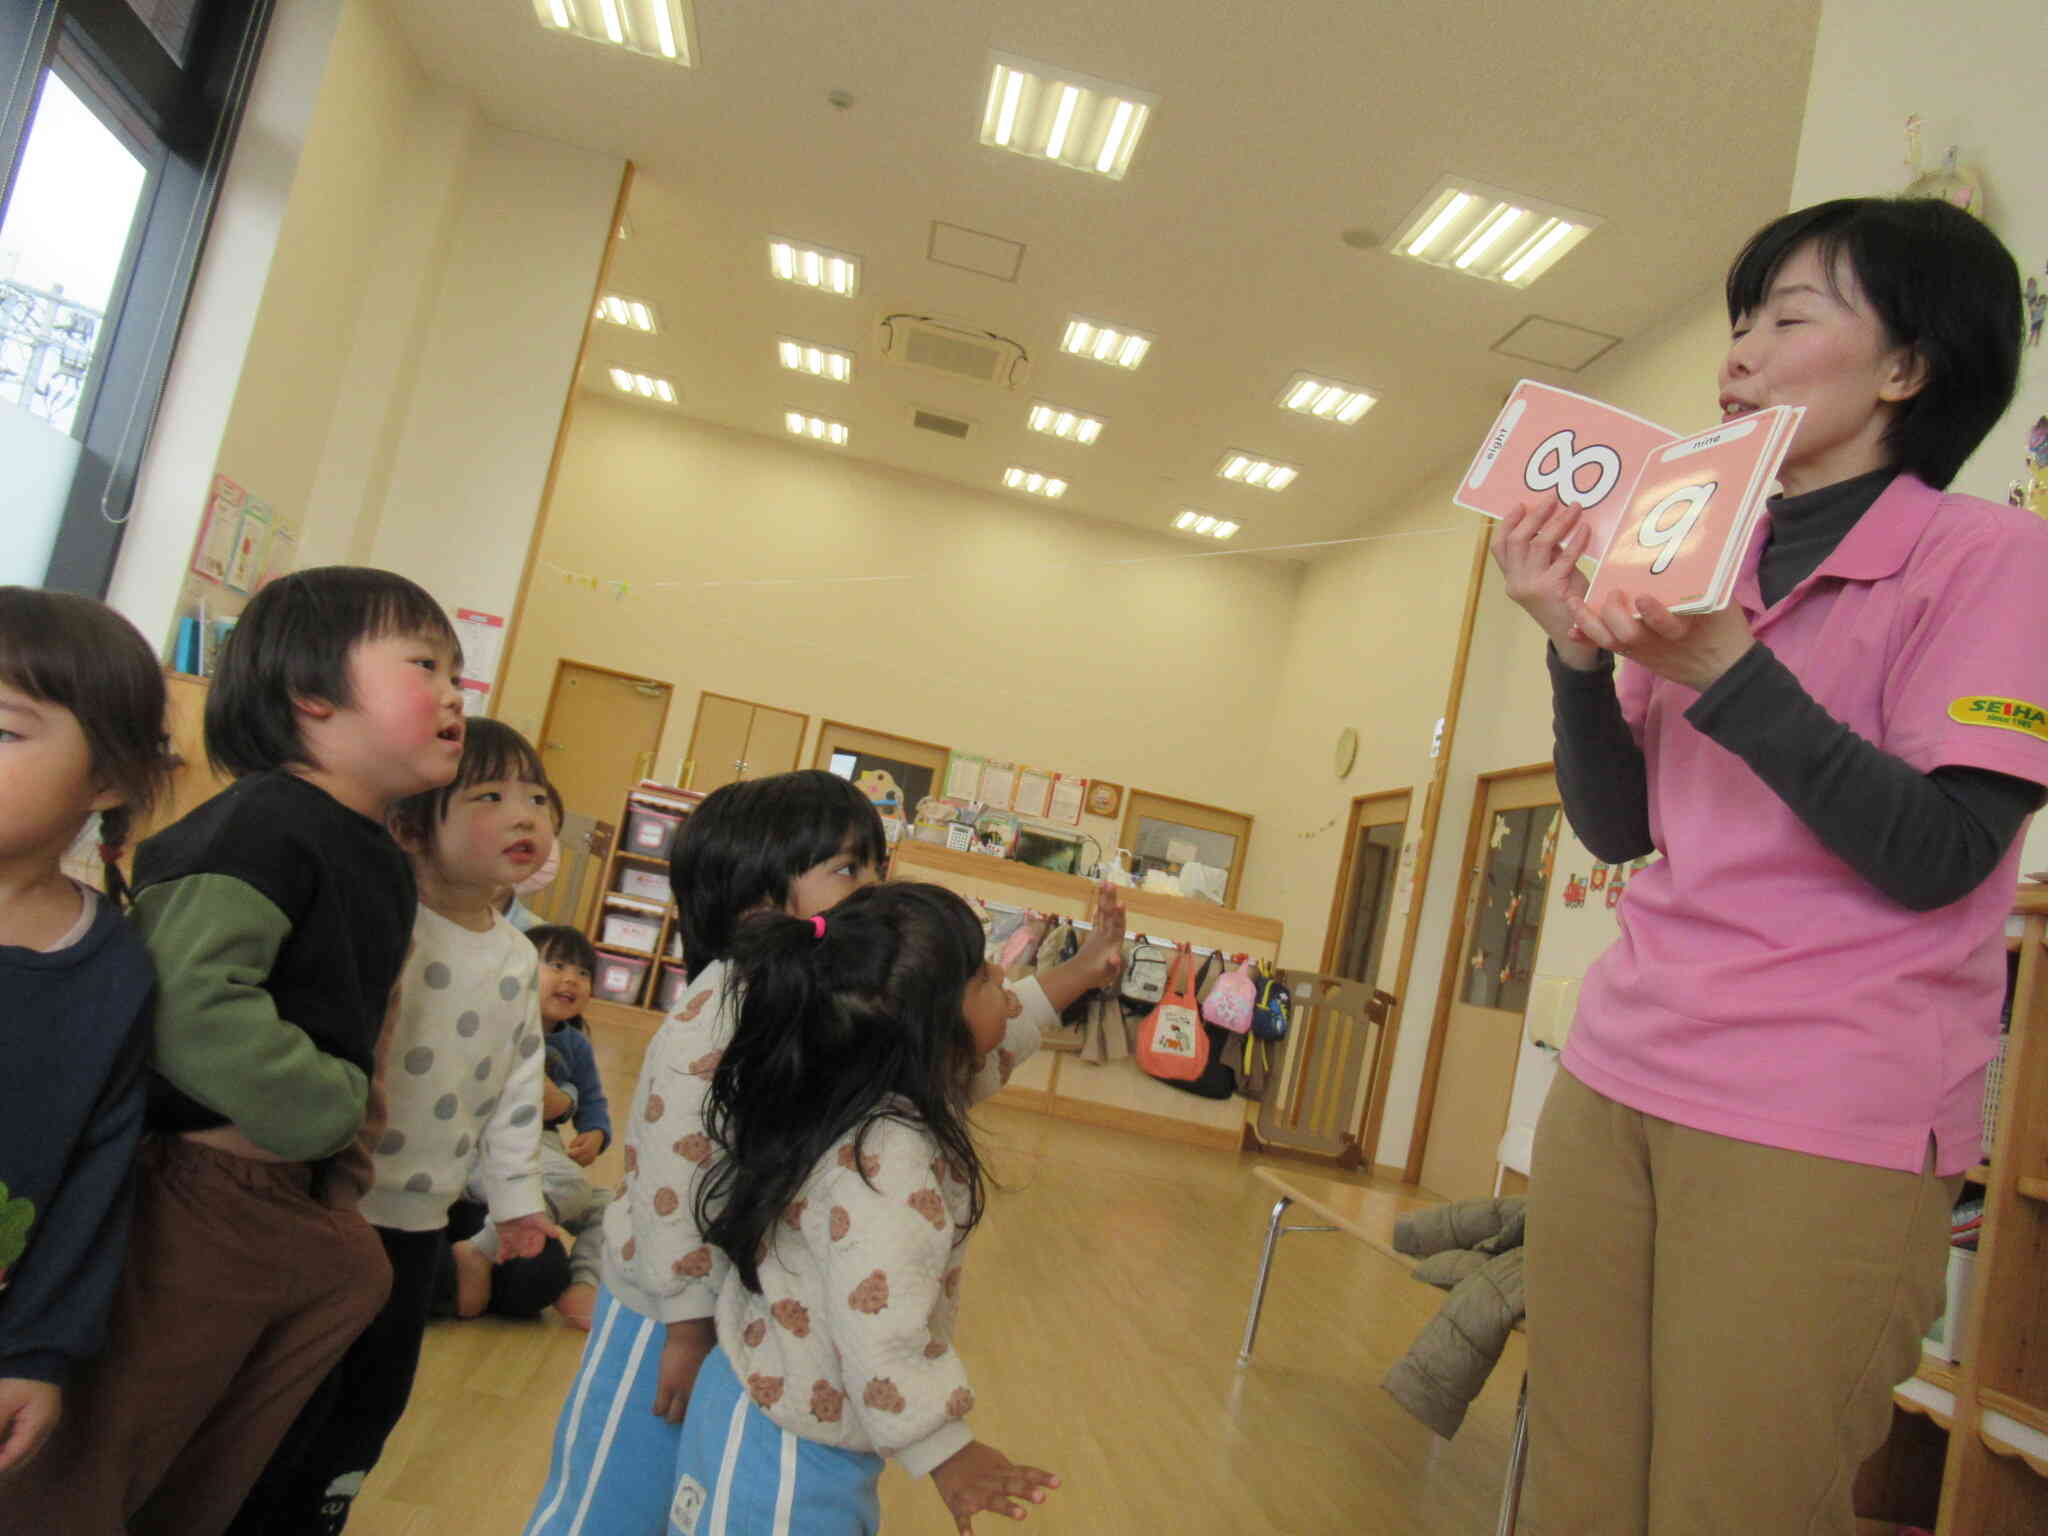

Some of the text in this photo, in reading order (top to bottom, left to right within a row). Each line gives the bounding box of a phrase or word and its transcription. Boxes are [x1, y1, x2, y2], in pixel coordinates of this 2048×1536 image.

[1487, 428, 1508, 460] eight
[1693, 435, 1721, 449] nine
[1524, 428, 1622, 510] 8
[1637, 480, 1719, 575] 9
[1968, 699, 2047, 726] SEIHA
